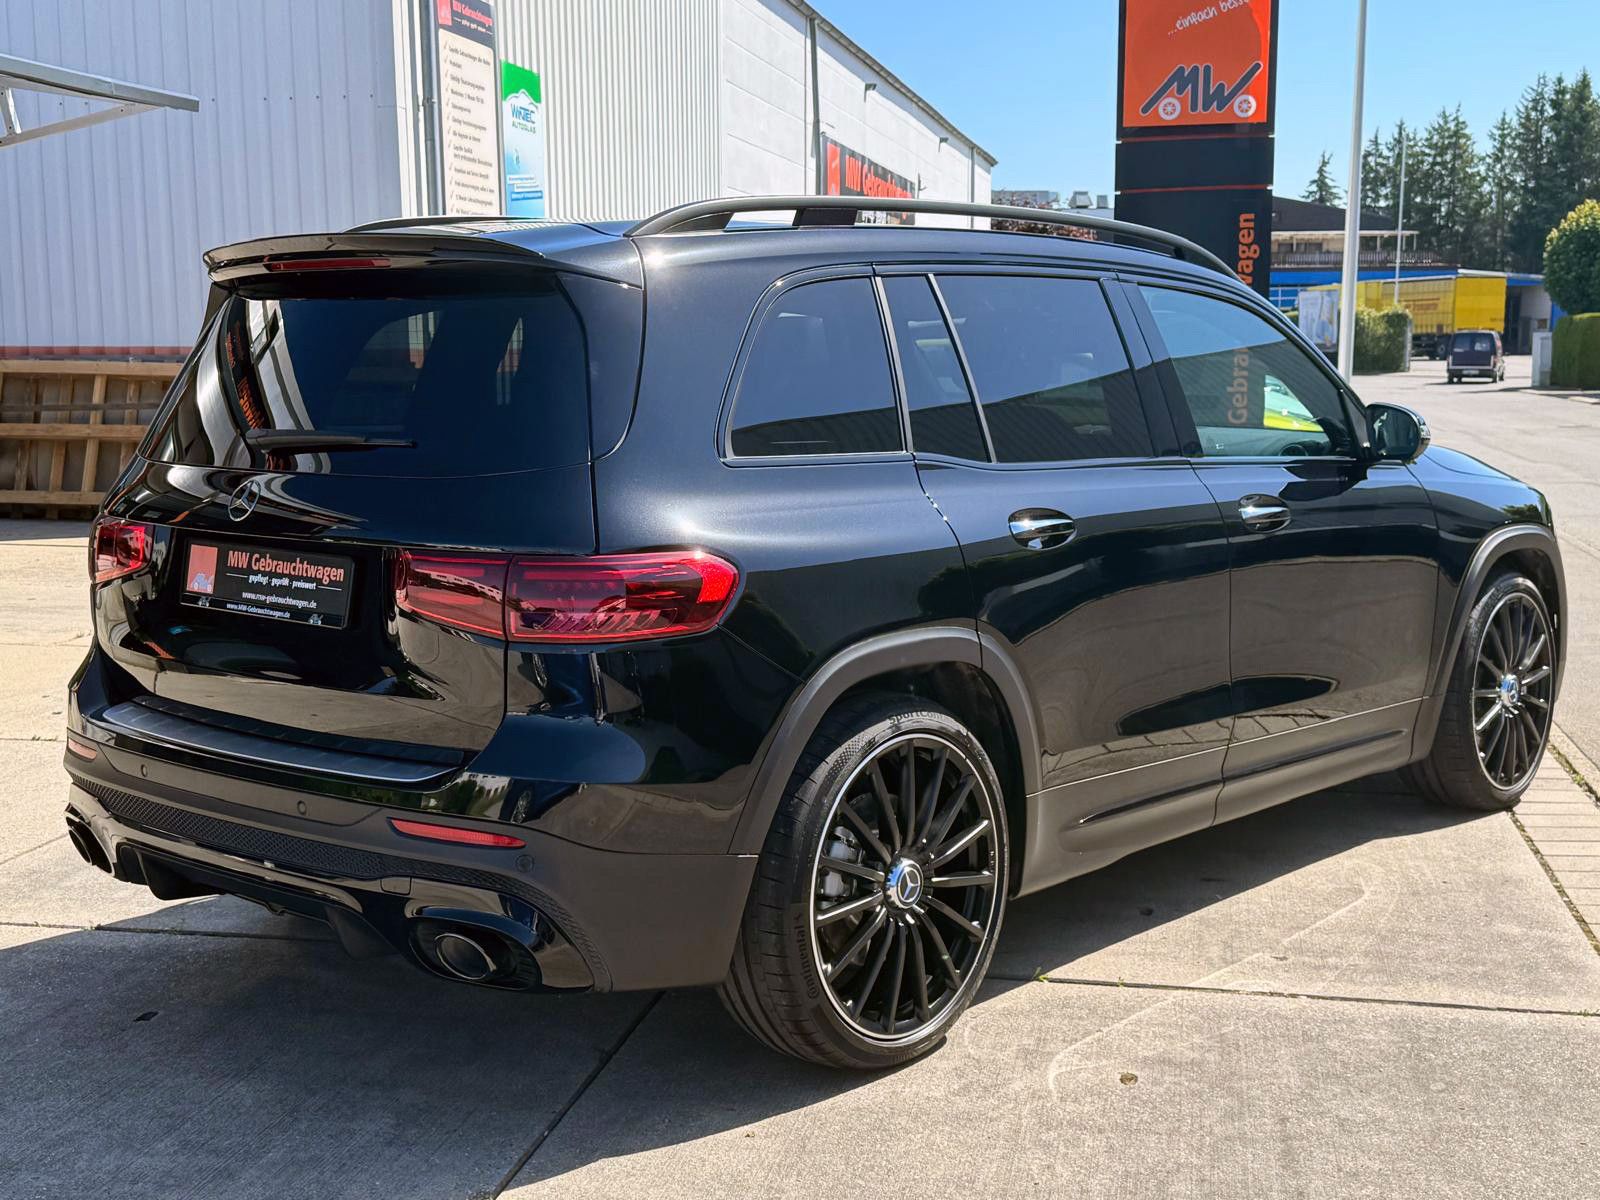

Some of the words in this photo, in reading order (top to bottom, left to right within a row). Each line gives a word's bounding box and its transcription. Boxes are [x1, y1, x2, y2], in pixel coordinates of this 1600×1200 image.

[1139, 60, 1263, 117] MW
[862, 164, 912, 199] Gebrauchtw
[1226, 348, 1249, 425] Gebra
[228, 550, 250, 569] MW
[251, 553, 344, 585] Gebrauchtwagen
[248, 573, 269, 586] gepflegt
[271, 577, 290, 587] geprüft
[292, 580, 317, 590] preiswert
[242, 591, 317, 609] www.mw-gebrauchtwagen.de
